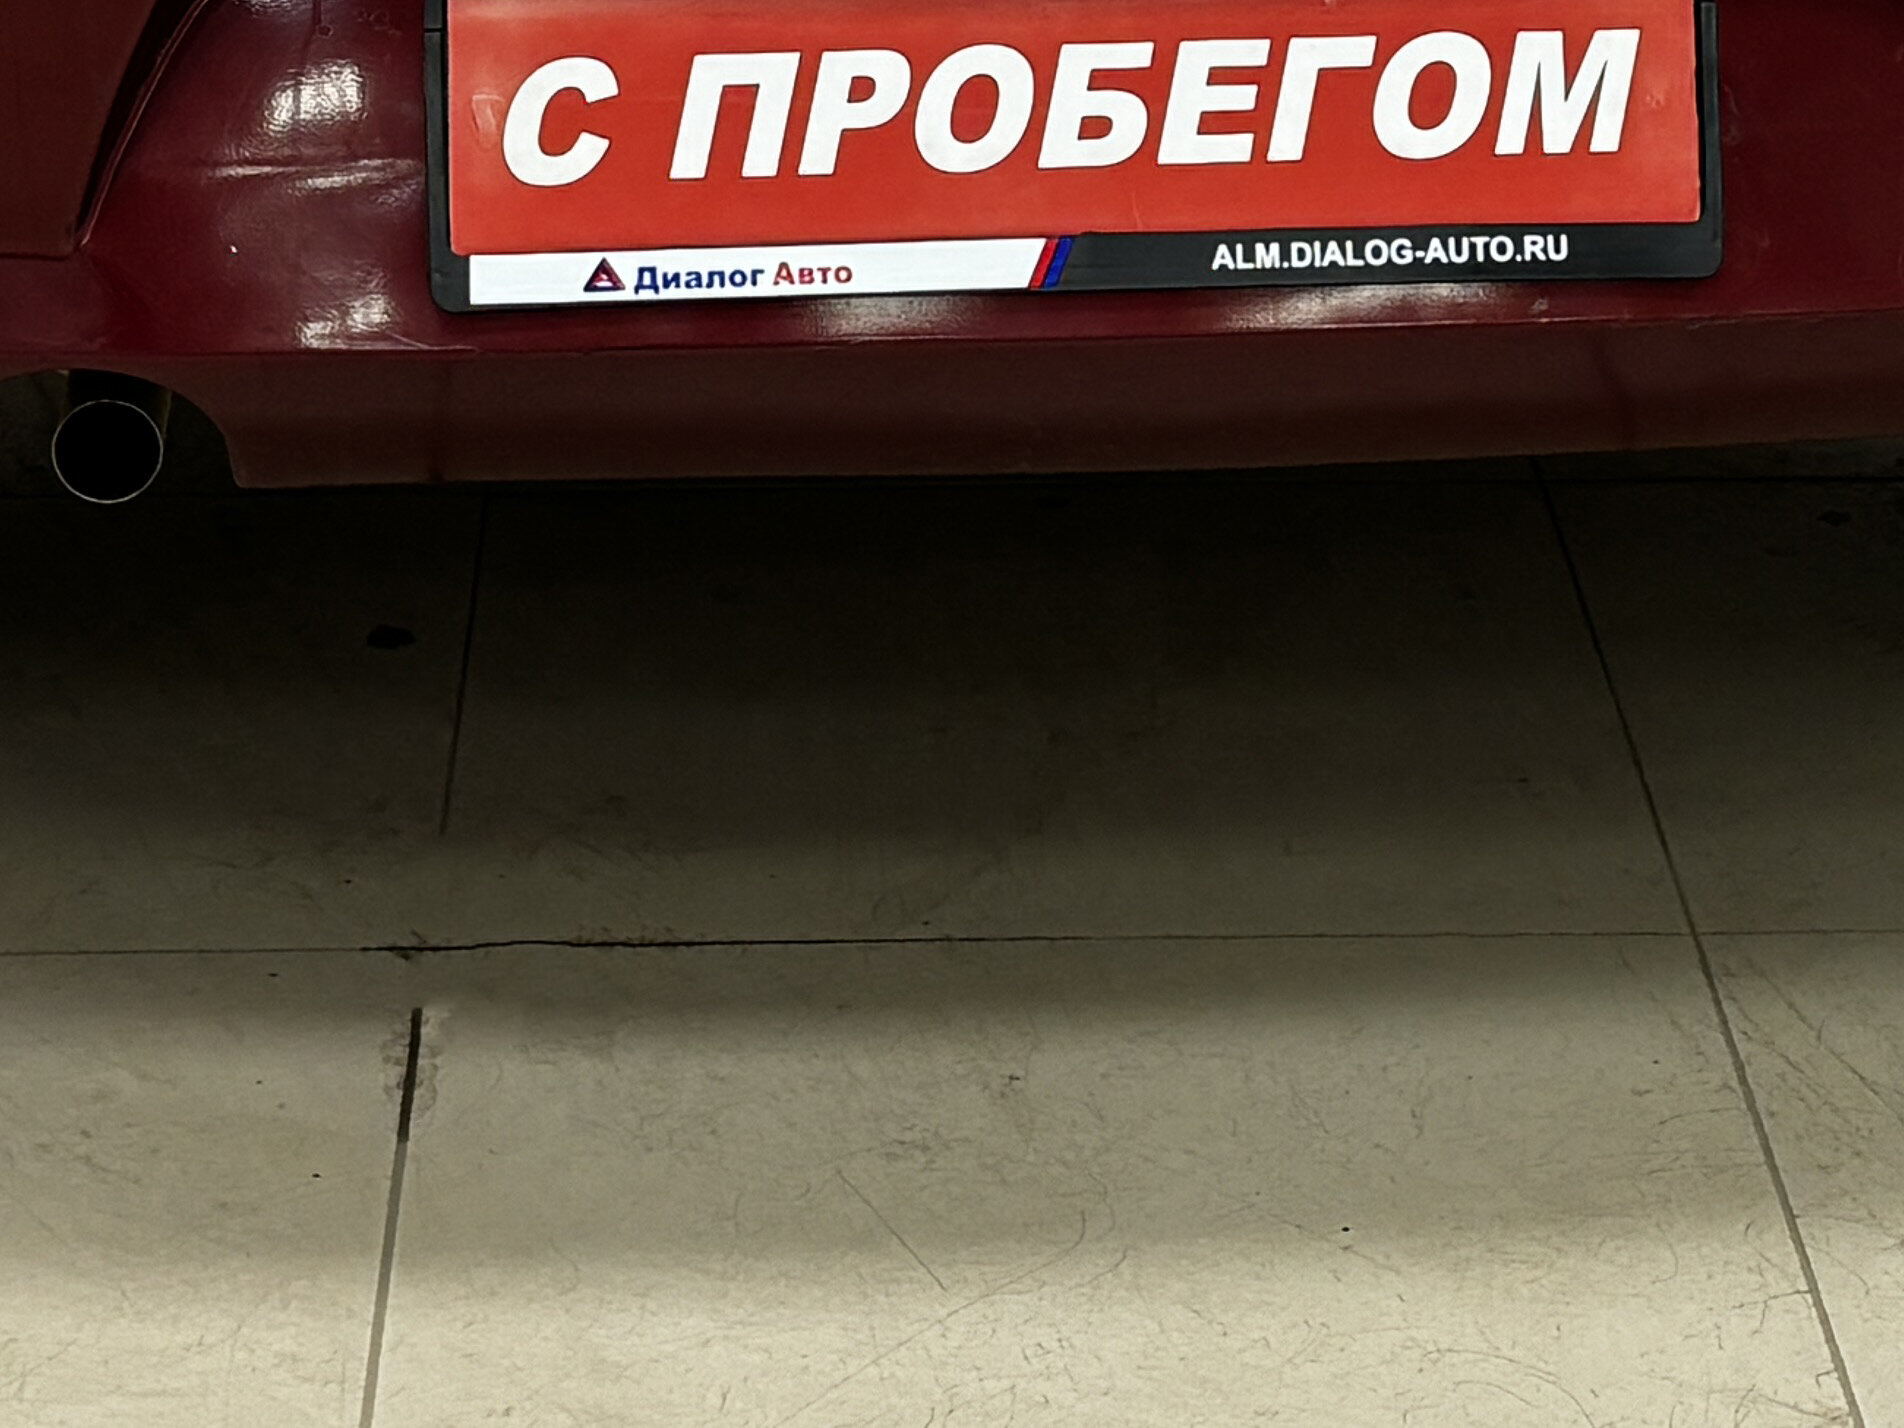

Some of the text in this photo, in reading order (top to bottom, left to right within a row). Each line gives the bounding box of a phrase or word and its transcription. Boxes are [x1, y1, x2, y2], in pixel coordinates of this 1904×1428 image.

[502, 27, 1641, 187] С ПРОБЕГОМ
[1210, 234, 1569, 271] ALM.DIALOG-AUTO.RU
[633, 261, 854, 295] Диалог Авто
